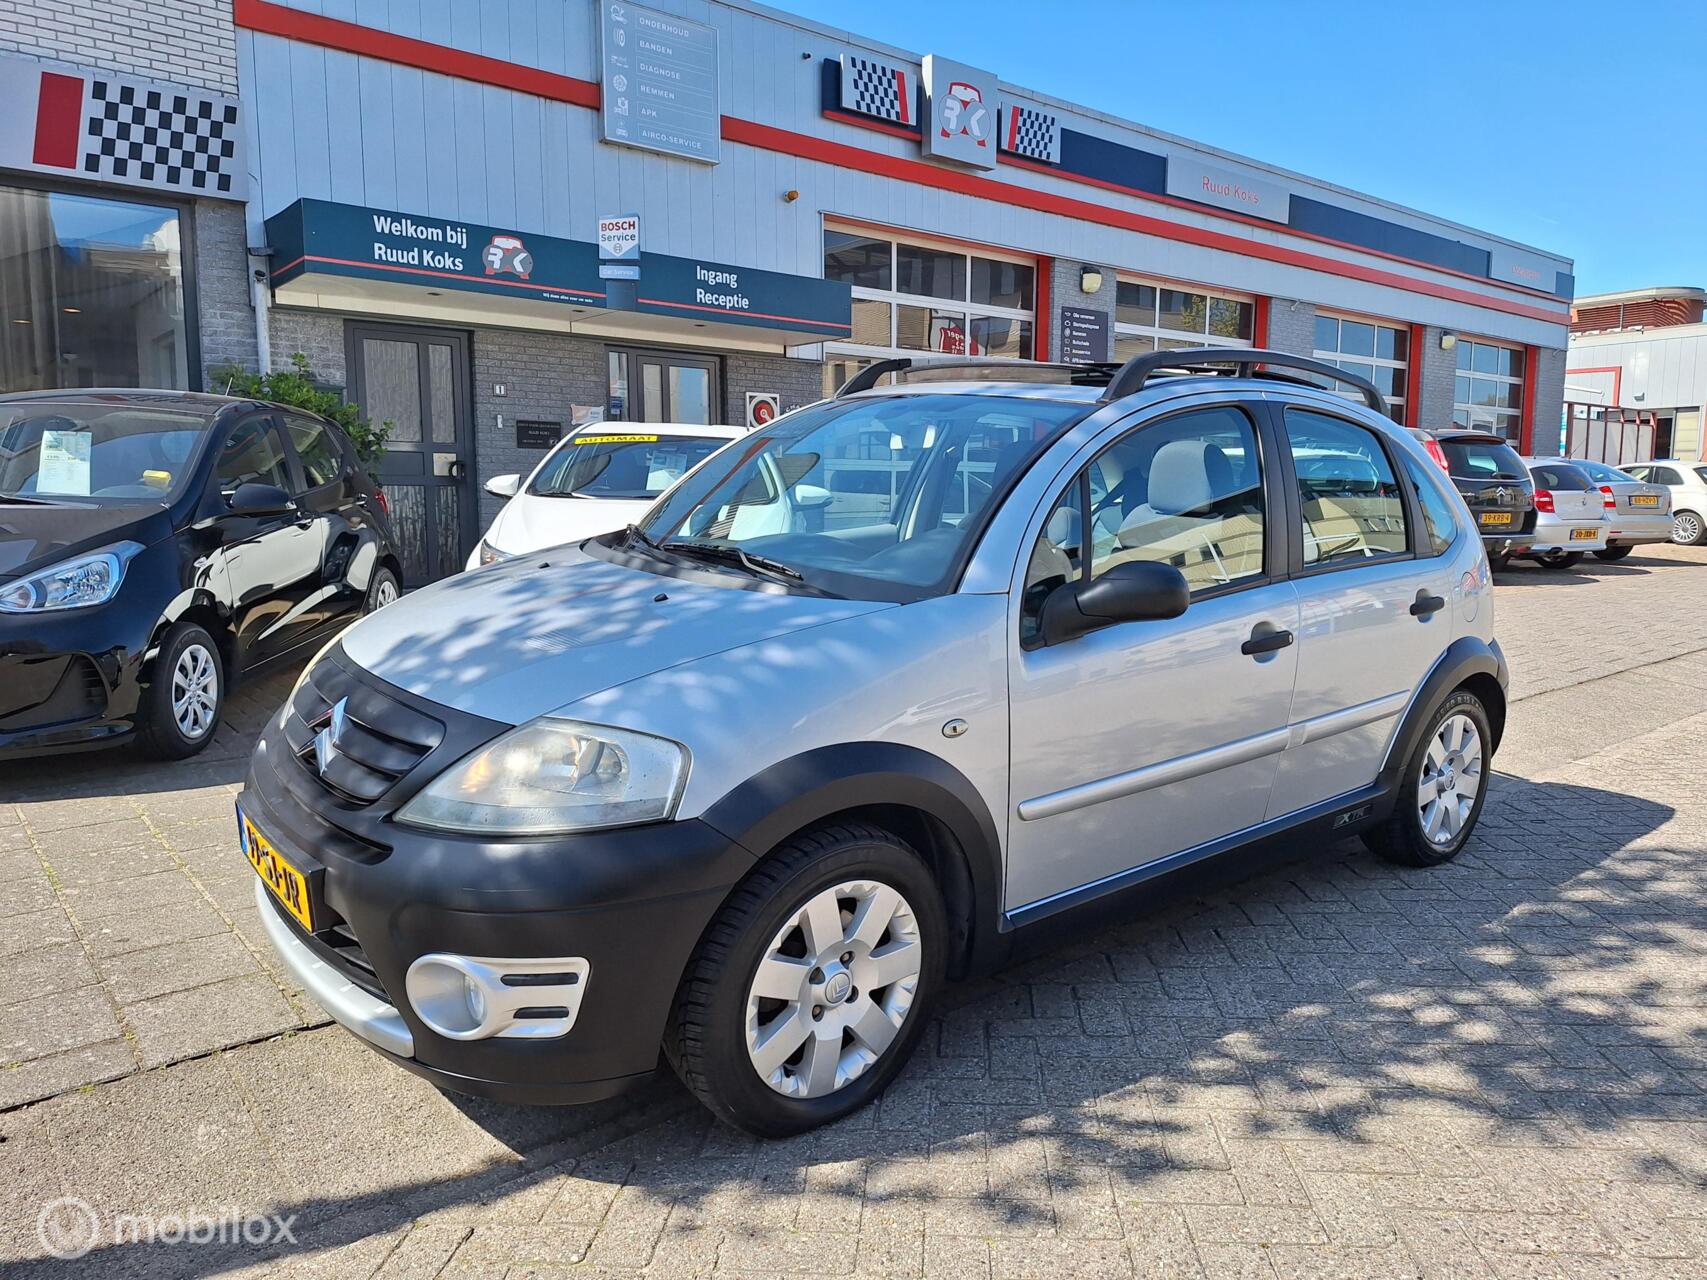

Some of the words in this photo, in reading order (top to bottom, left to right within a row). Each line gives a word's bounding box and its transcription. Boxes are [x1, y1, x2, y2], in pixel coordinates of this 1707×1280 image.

[639, 18, 689, 37] ONDERHOUD
[639, 41, 672, 55] BANDEN
[640, 63, 681, 80] DIAGNOSE
[640, 85, 675, 100] REMMEN
[641, 107, 657, 118] APK
[642, 130, 702, 149] AIRCO-SERVICE
[1202, 175, 1230, 196] Ruud
[1234, 184, 1260, 204] Koks
[373, 215, 443, 242] Welkom
[446, 226, 467, 249] bij
[601, 220, 636, 231] BOSCH
[601, 232, 636, 241] Service
[374, 242, 419, 265] Ruud
[423, 250, 464, 271] Koks
[696, 266, 738, 288] Ingang
[696, 289, 749, 310] Receptie
